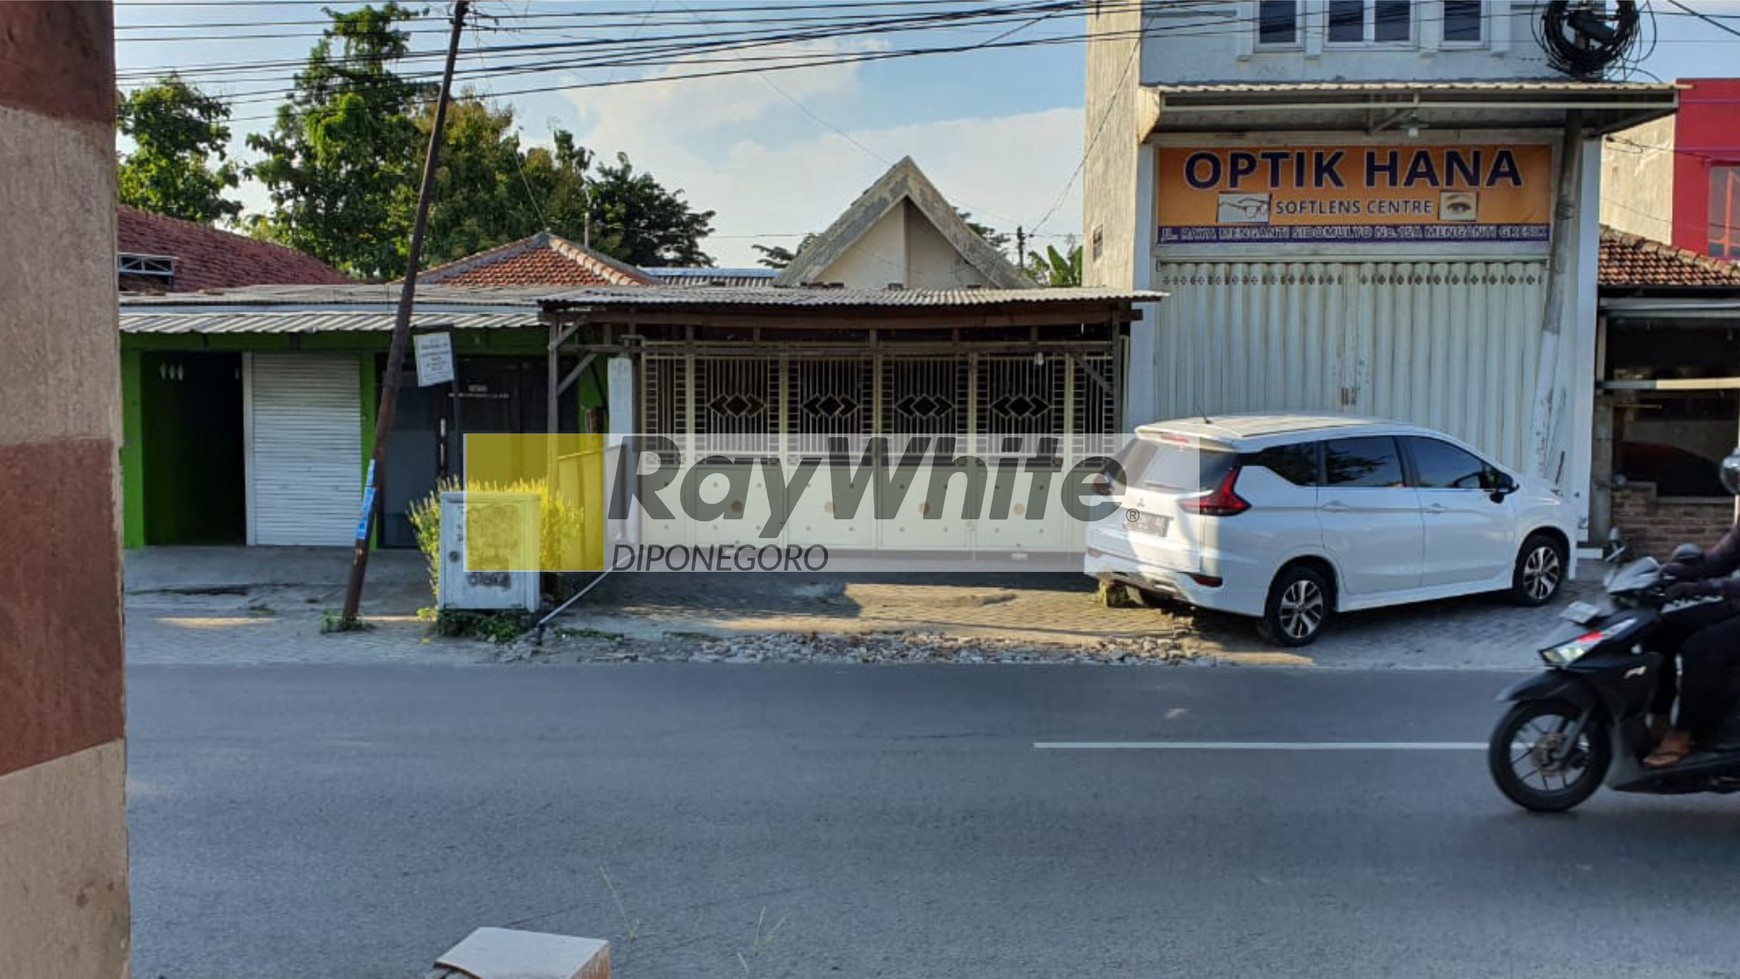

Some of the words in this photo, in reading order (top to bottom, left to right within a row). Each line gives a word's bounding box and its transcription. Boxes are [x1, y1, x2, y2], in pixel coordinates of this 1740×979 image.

[1184, 149, 1345, 189] OPTIK
[1365, 148, 1523, 188] HANA
[1275, 199, 1360, 215] SOFTLENS
[1367, 199, 1432, 215] CENTRE
